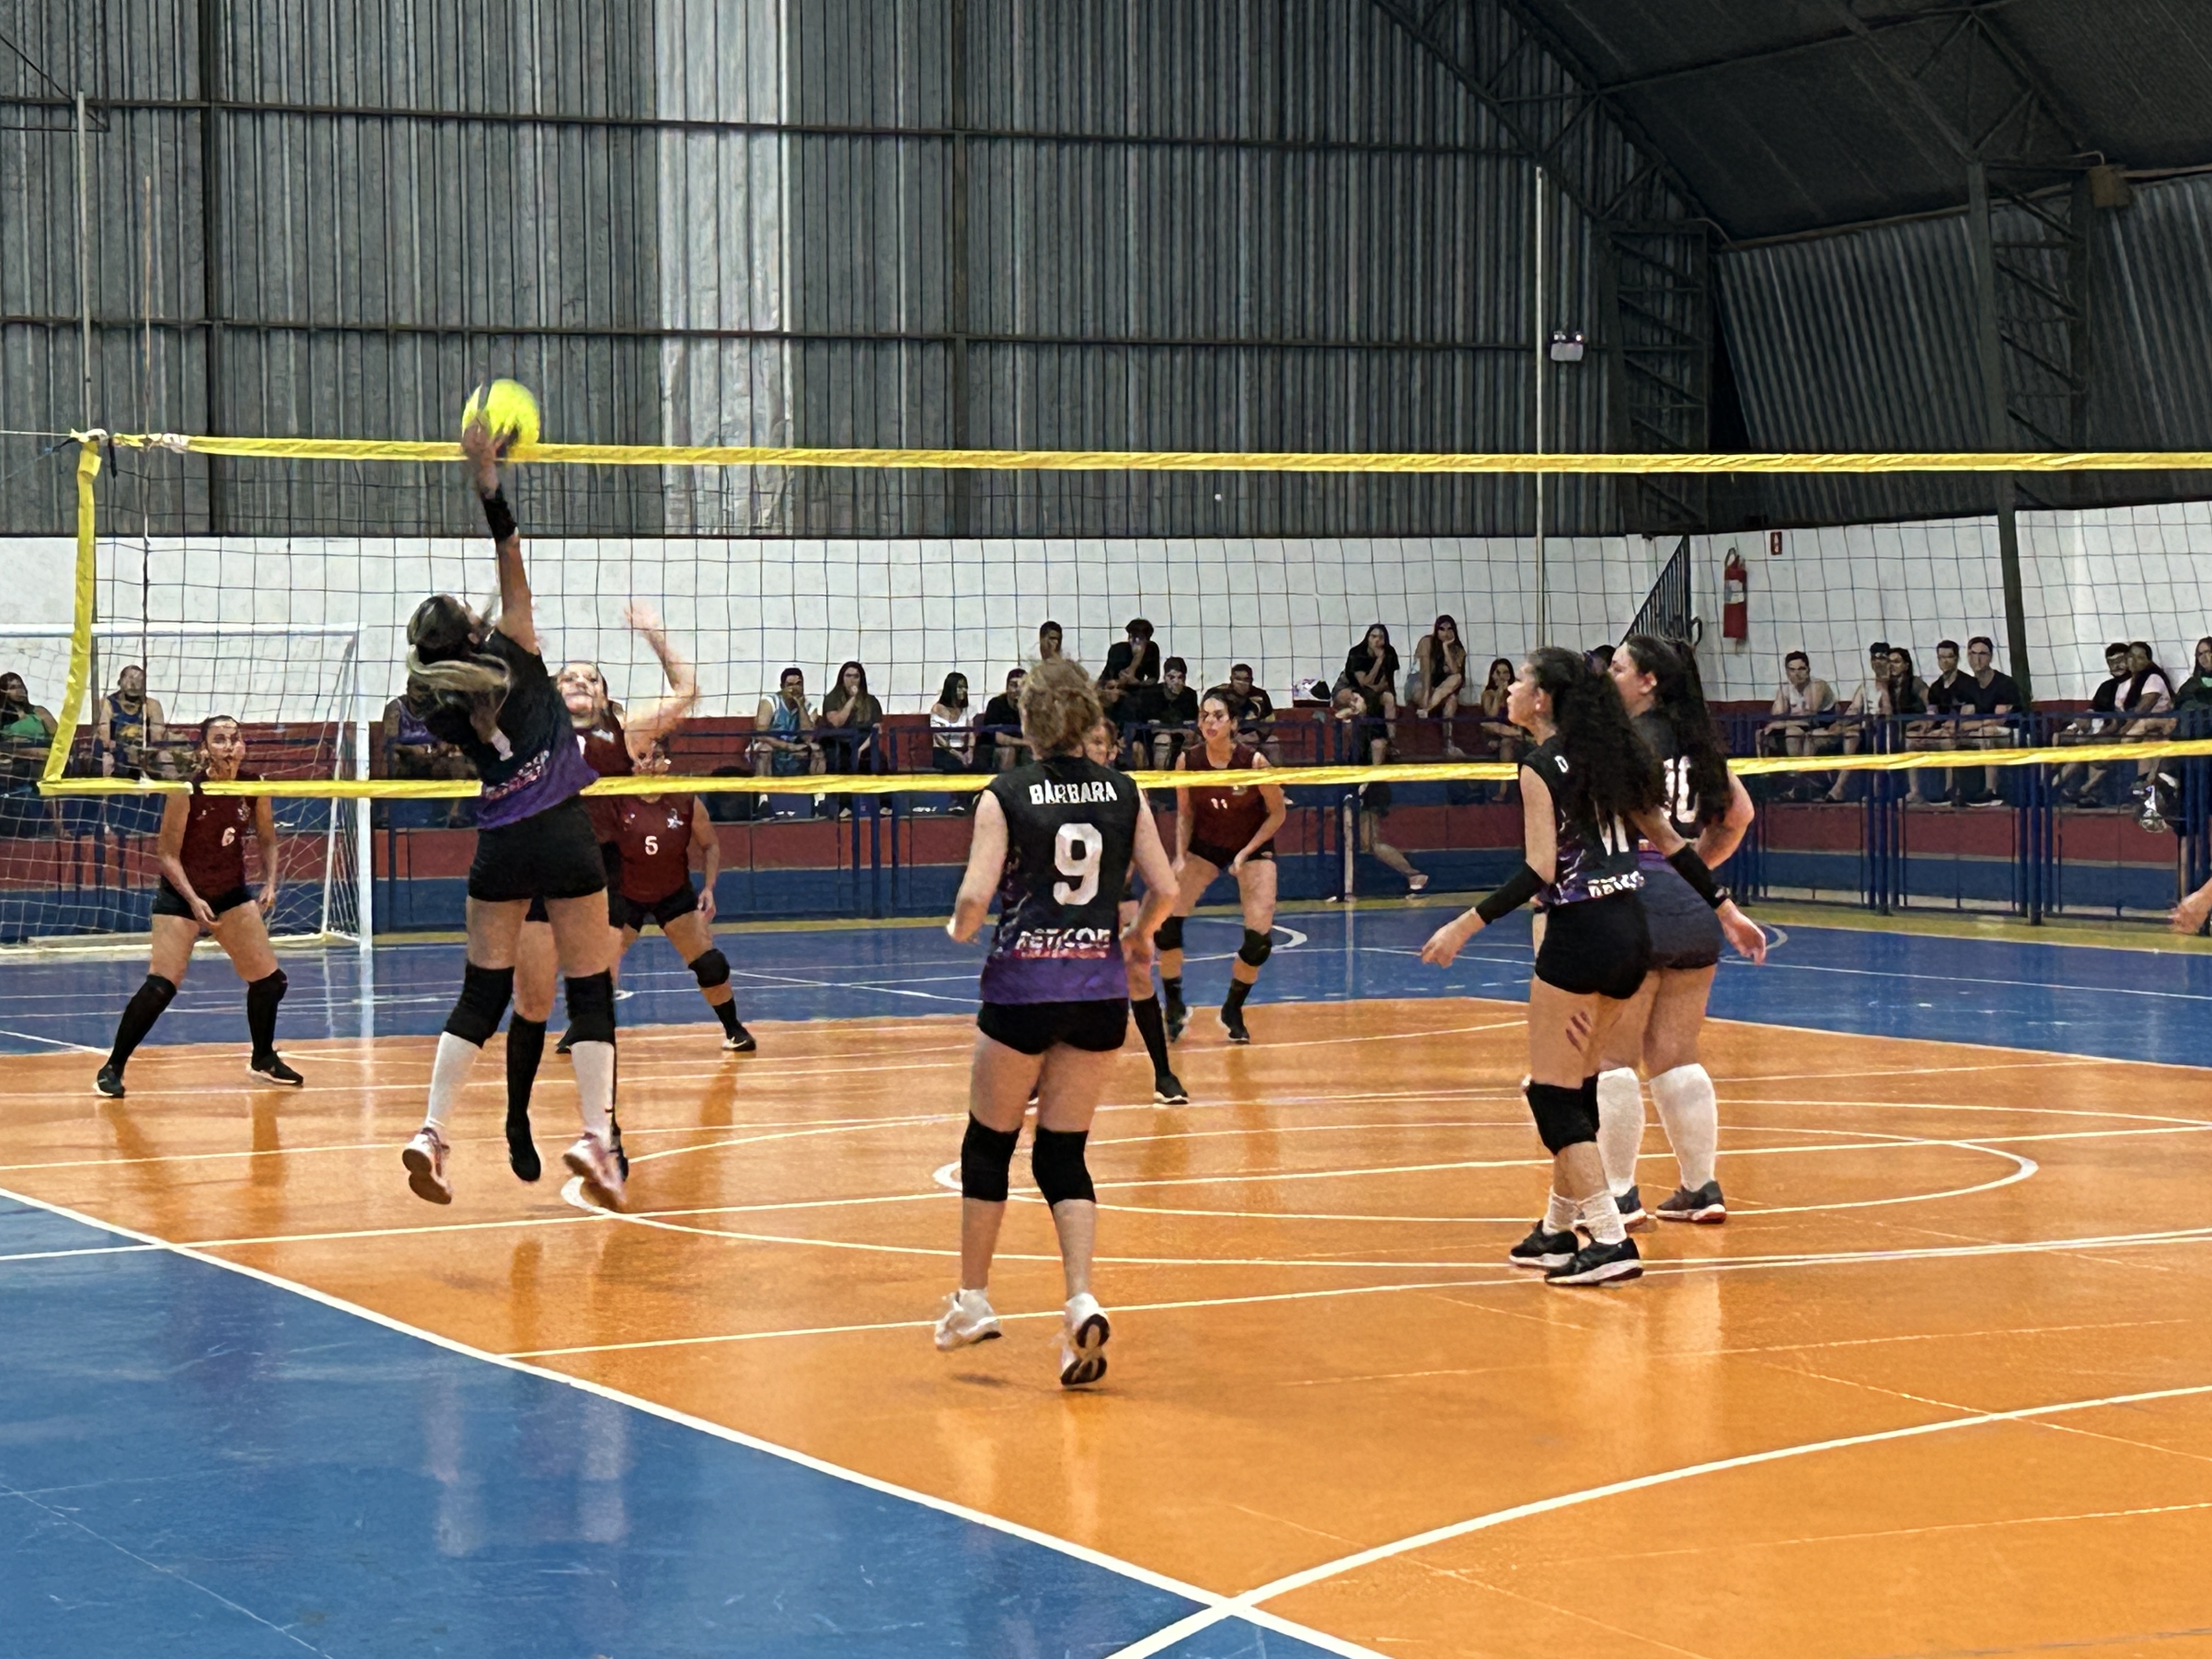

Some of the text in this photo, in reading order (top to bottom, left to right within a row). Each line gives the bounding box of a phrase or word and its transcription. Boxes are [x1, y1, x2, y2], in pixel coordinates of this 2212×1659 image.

[221, 826, 236, 847] 6
[645, 836, 658, 855] 5
[1053, 823, 1103, 906] 9
